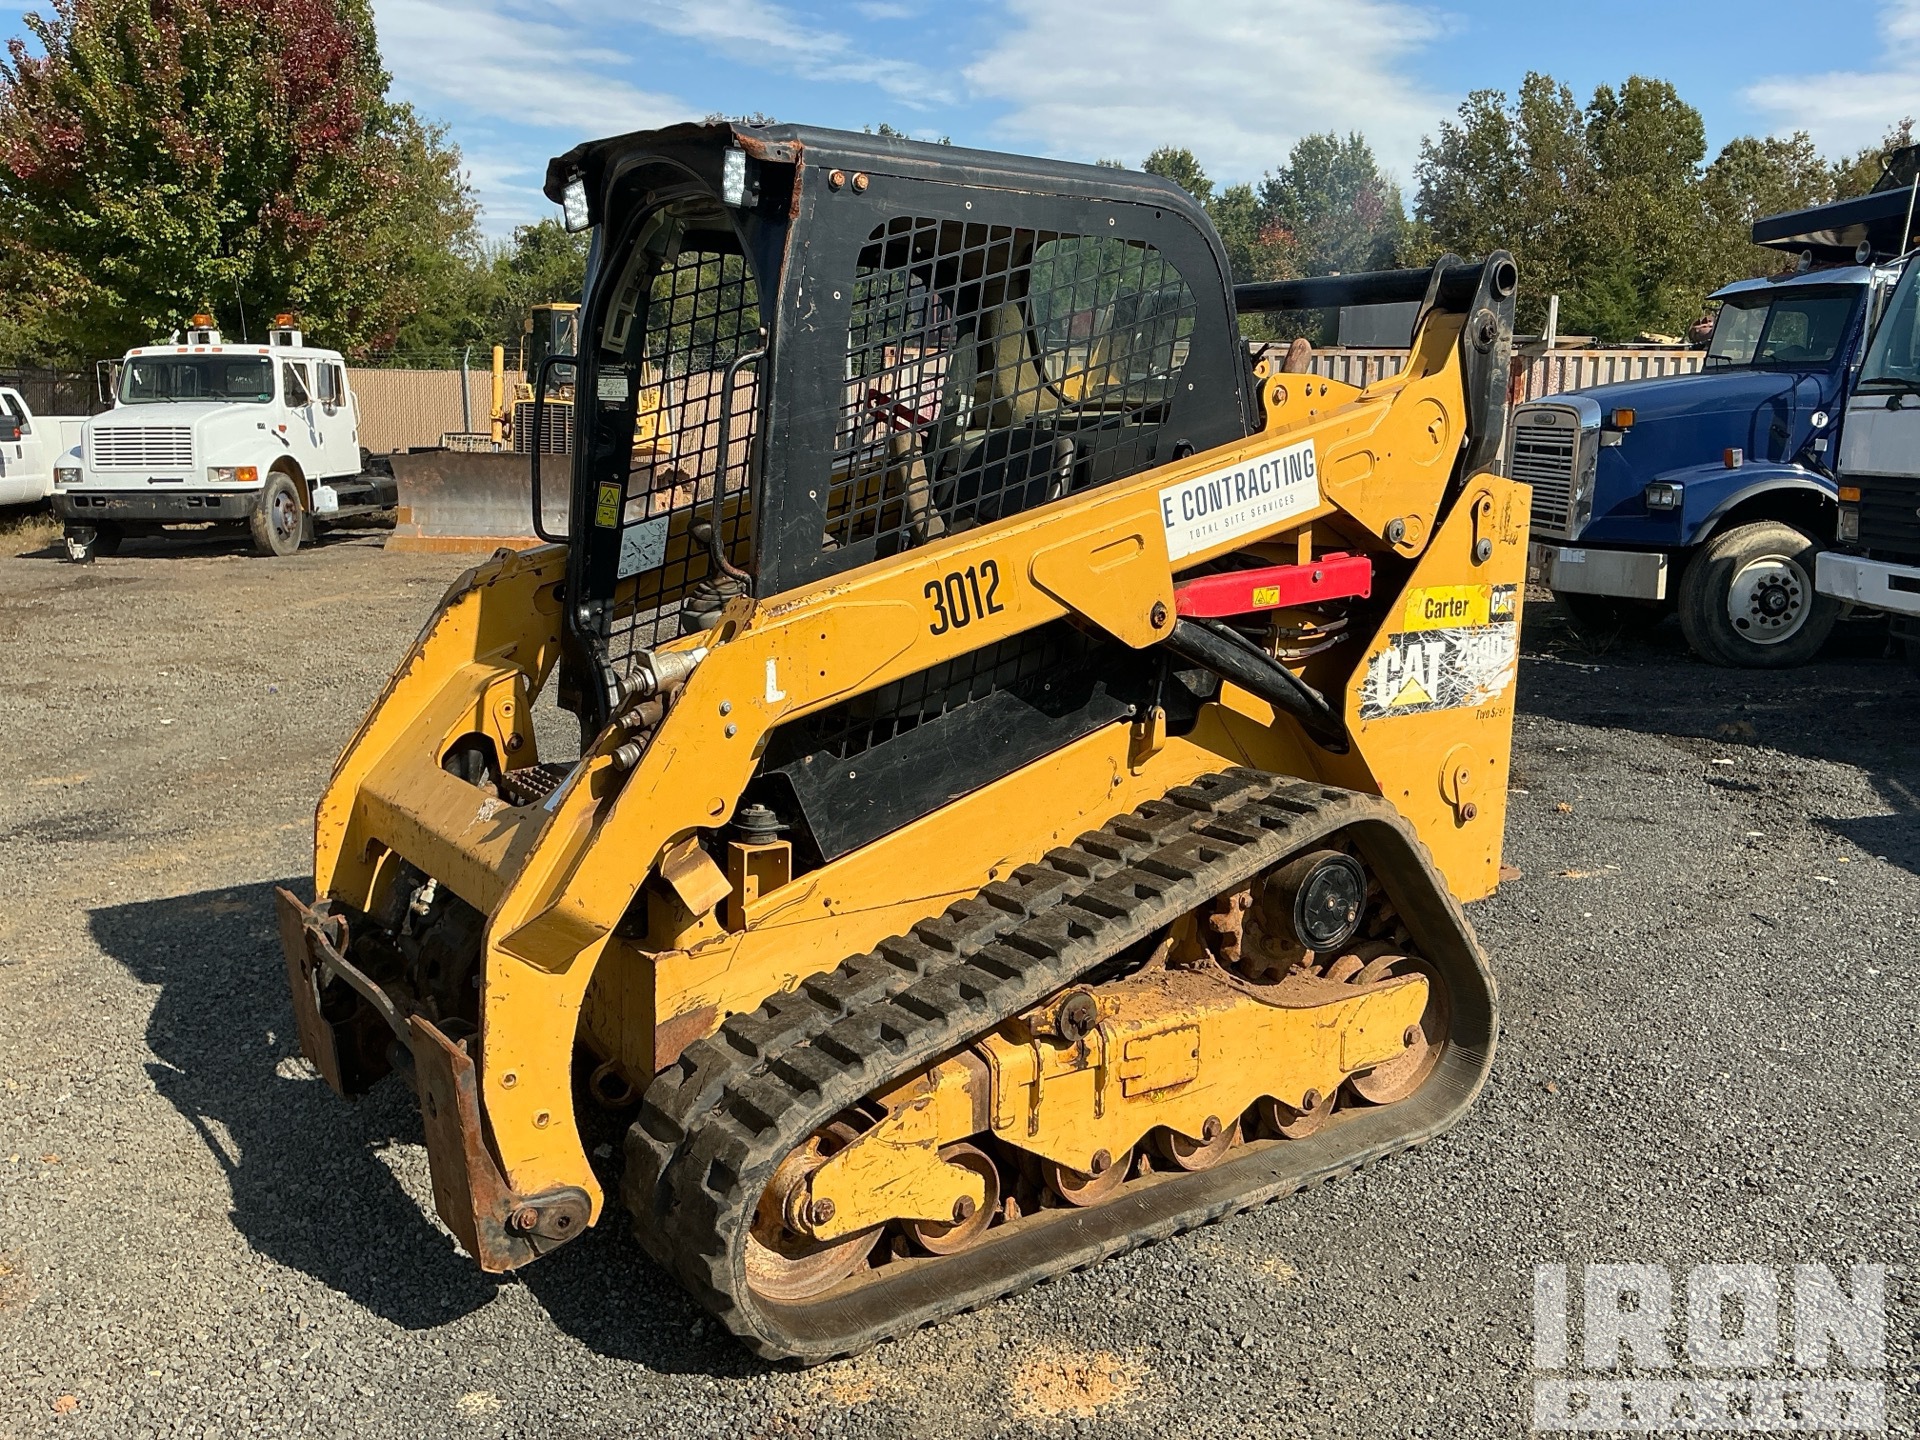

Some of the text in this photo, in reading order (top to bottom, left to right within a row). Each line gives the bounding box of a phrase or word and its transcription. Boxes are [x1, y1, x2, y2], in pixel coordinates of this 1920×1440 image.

[1162, 448, 1315, 529] E CONTRACTING
[1189, 494, 1295, 540] TOTAL SITE SERVICES
[924, 559, 1004, 636] 3012
[1424, 597, 1470, 619] Carter
[765, 656, 787, 703] L
[1376, 642, 1446, 708] CAT
